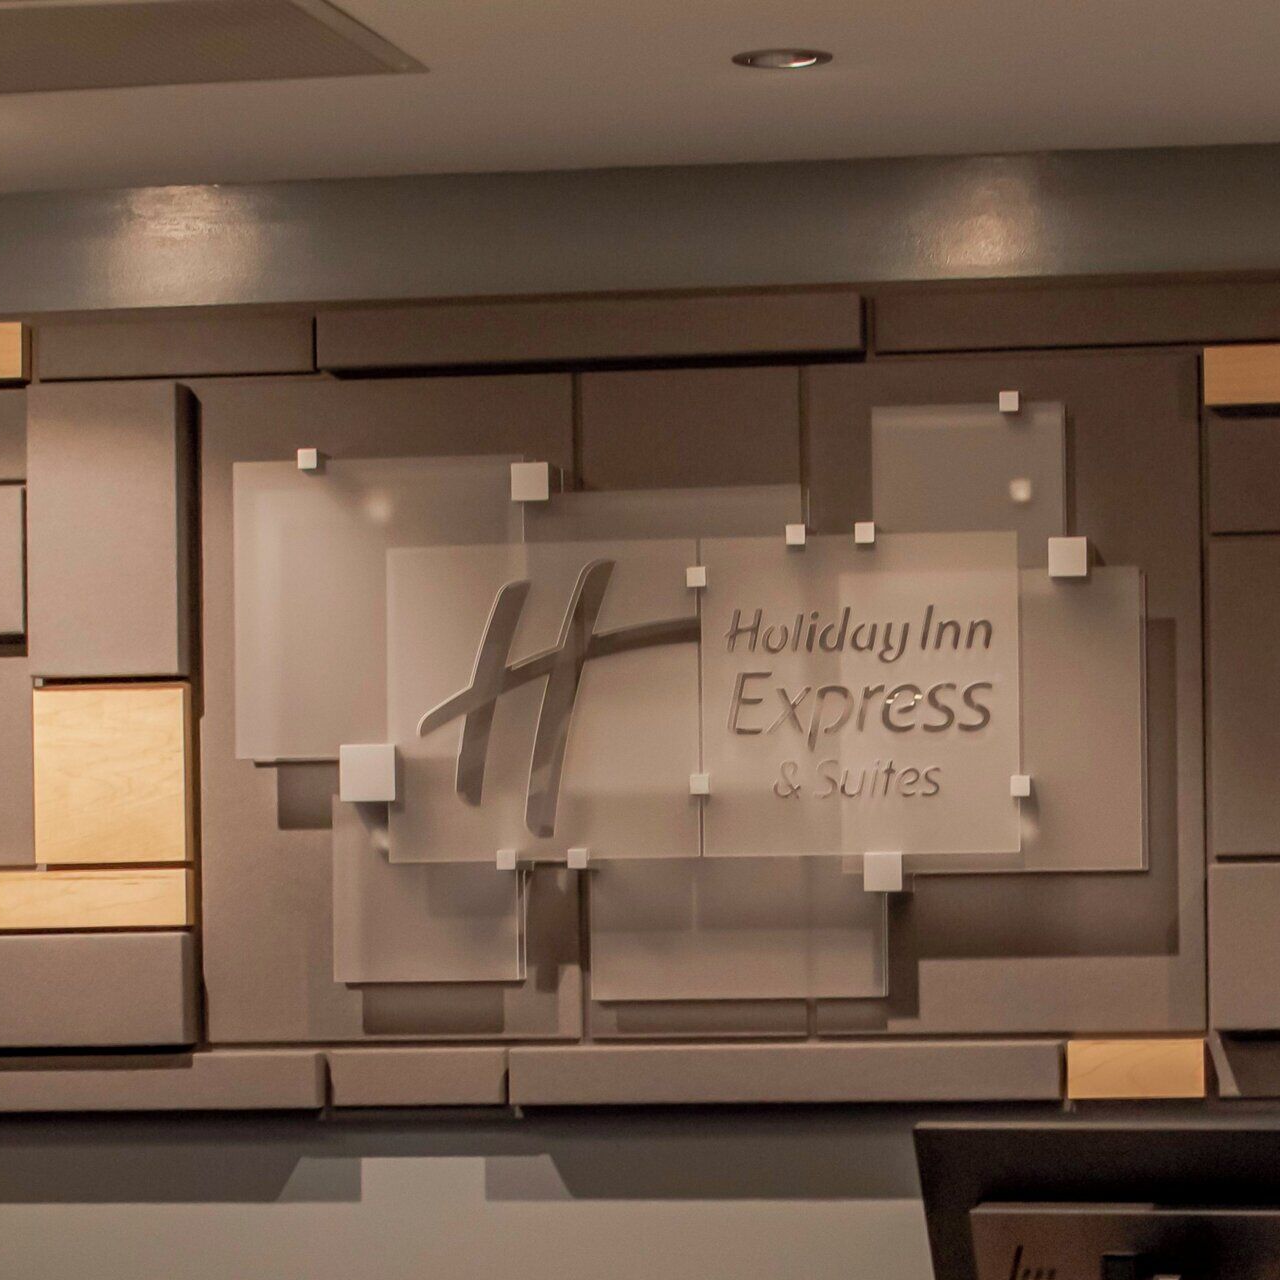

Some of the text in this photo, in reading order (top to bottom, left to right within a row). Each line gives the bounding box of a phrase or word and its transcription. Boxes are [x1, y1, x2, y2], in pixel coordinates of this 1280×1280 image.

[723, 604, 994, 664] Holiday Inn
[726, 671, 994, 752] Express
[773, 758, 942, 799] & Suites
